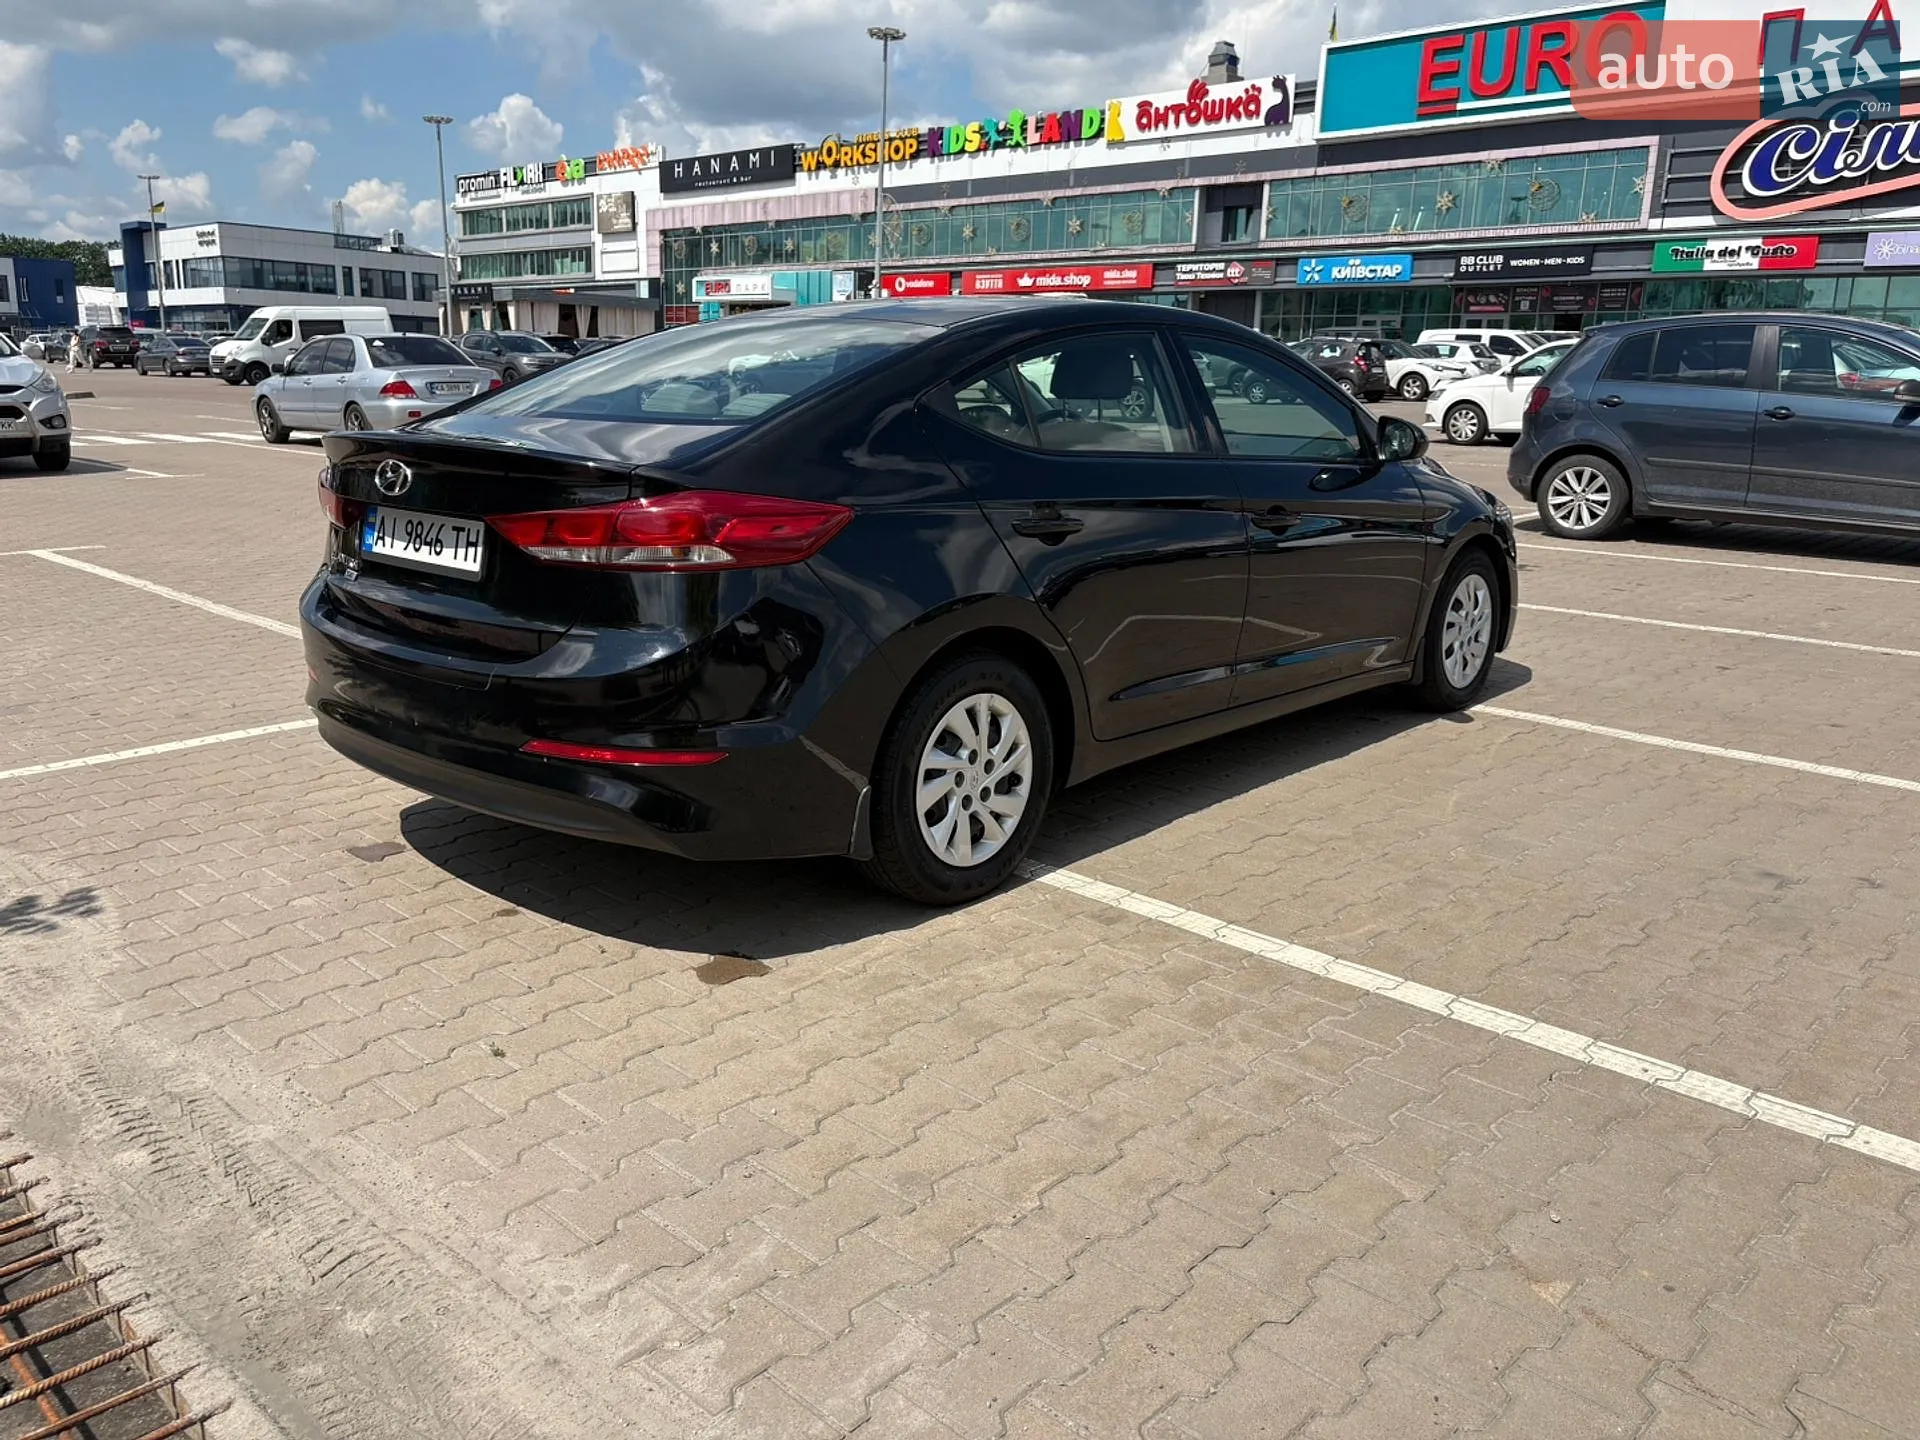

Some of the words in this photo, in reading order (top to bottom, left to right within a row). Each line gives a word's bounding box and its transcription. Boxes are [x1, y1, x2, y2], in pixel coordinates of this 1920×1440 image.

[1418, 11, 1650, 104] EURO
[927, 124, 982, 155] KIDS
[1026, 107, 1102, 146] LAND
[800, 138, 918, 172] WORKSHOP
[674, 150, 775, 179] HANAMI
[1460, 256, 1475, 265] BB
[1476, 255, 1504, 264] CLUB
[1671, 246, 1714, 260] Italia
[1718, 245, 1742, 258] del
[1745, 244, 1796, 258] Gusto
[1103, 268, 1138, 279] mida.shop
[1331, 258, 1403, 280] КИЇВСТАР
[1460, 264, 1503, 272] OUTLET
[705, 281, 732, 296] EURO
[905, 279, 935, 288] vodafone
[1036, 273, 1092, 288] mida.shop
[403, 518, 444, 557] 9846
[451, 524, 481, 564] TH
